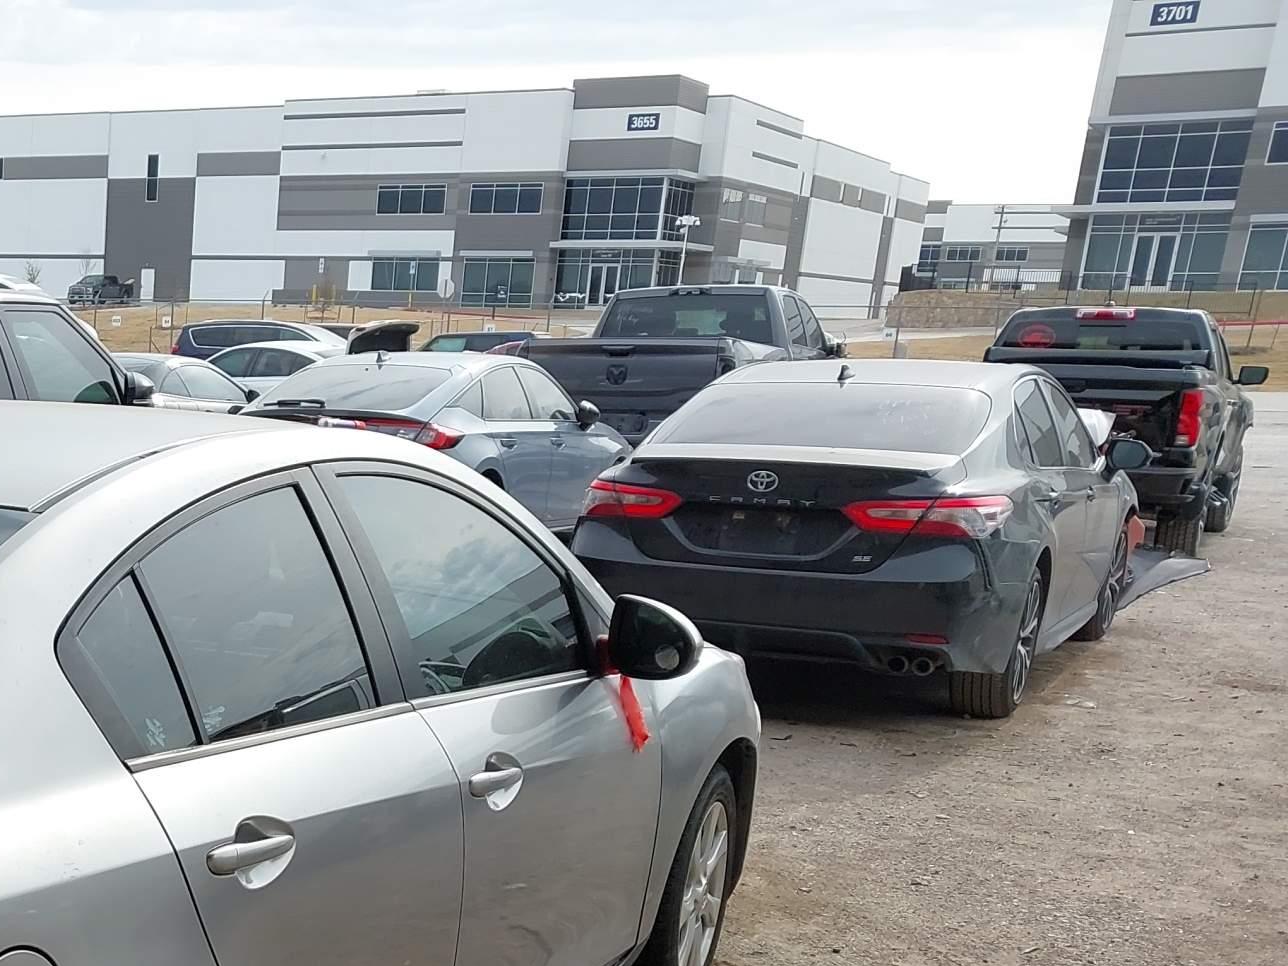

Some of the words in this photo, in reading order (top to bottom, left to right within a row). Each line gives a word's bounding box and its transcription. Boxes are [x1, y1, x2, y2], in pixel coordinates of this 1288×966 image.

[1157, 5, 1194, 22] 3701
[631, 116, 656, 128] 3655
[709, 495, 815, 507] CAMRY
